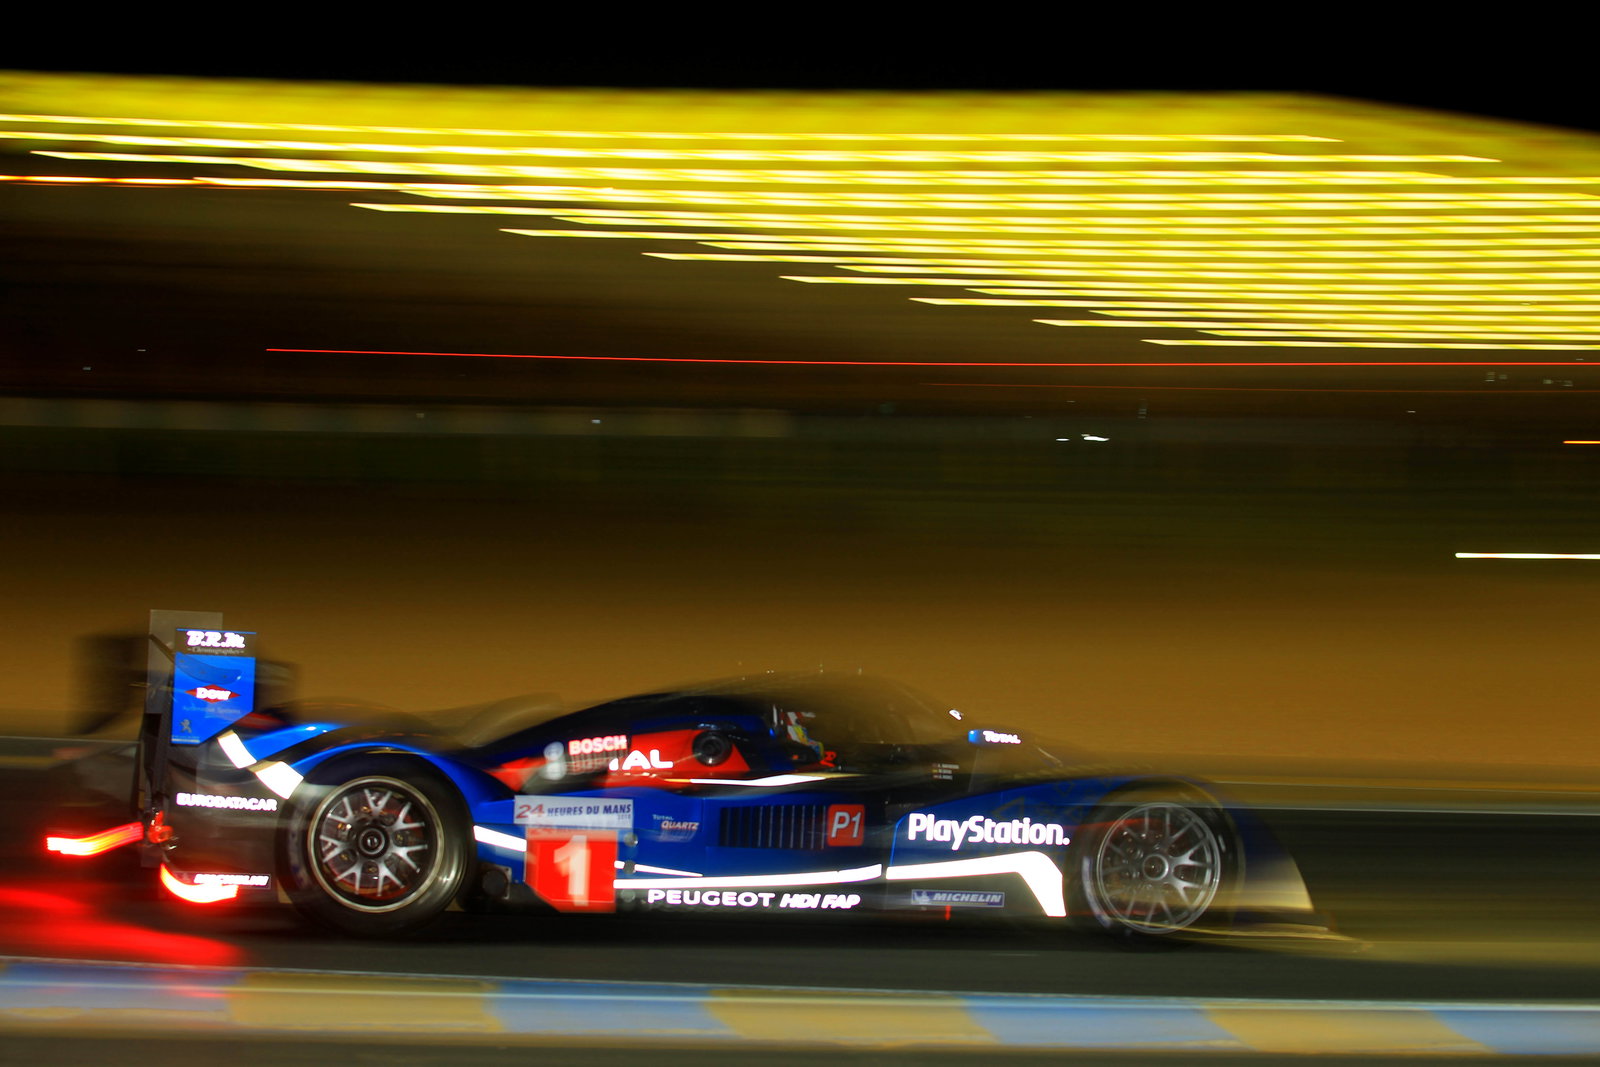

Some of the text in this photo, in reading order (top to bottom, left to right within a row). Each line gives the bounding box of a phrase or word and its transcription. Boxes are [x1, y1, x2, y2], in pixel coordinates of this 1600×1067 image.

[568, 735, 627, 755] BOSCH
[515, 803, 632, 820] 24 HEURES DU MANS
[661, 820, 700, 830] QUARTZ
[830, 811, 862, 839] P1
[553, 834, 592, 907] 1
[647, 889, 861, 909] PEUGEOT HDI FAP
[932, 892, 1002, 903] MICHELIN
